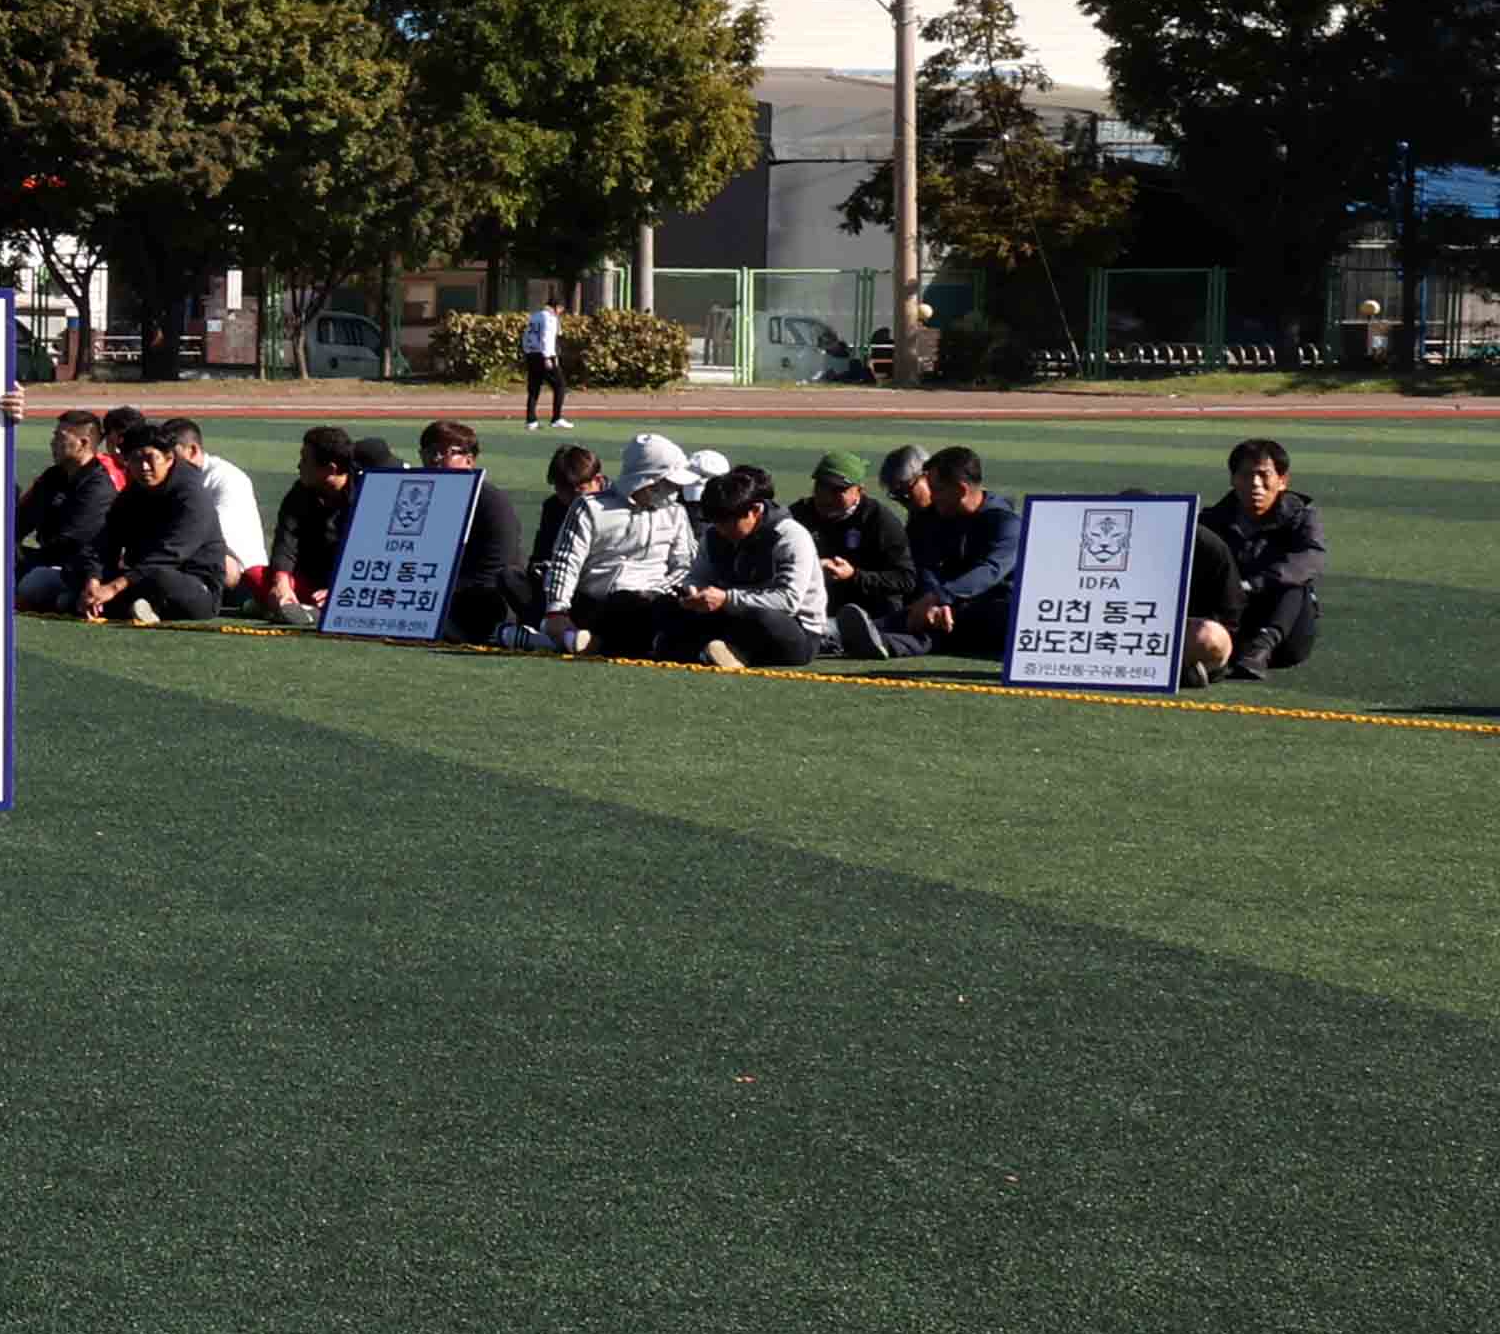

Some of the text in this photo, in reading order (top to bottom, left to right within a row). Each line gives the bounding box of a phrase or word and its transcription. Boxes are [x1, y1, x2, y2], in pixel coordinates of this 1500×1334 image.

[350, 559, 438, 584] 인천 동구
[1079, 576, 1121, 590] IDFA
[336, 586, 439, 612] 송현축구회
[1037, 599, 1157, 625] 인천 동구
[1017, 629, 1170, 657] 화도진축구회
